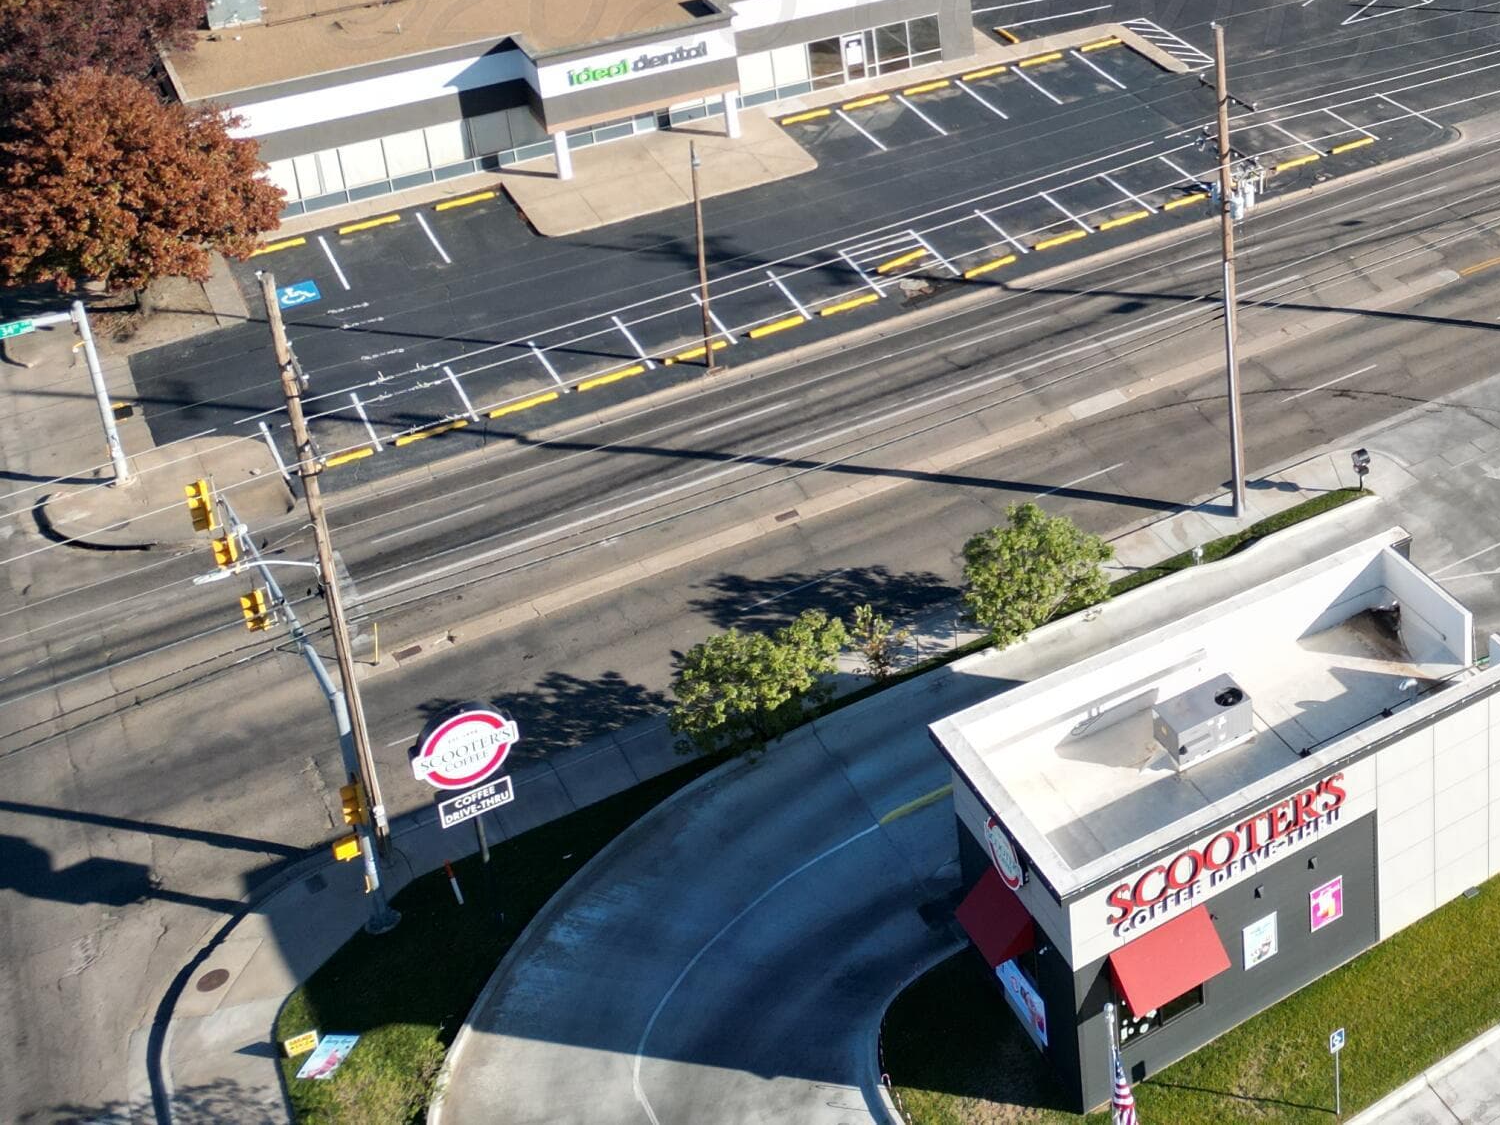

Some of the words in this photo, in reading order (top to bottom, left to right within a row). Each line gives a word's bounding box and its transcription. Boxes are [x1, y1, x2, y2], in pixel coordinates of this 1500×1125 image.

[567, 58, 629, 86] ideal
[631, 41, 708, 72] dental
[420, 729, 511, 771] SCOOTER'S
[445, 750, 489, 772] COFFEE
[445, 790, 509, 824] DRIVE-THRU
[454, 785, 496, 809] COFFEE
[1106, 772, 1347, 925] SCOOTER'S
[1113, 882, 1201, 937] COFFEE
[1209, 806, 1343, 888] DRIVE-THRU
